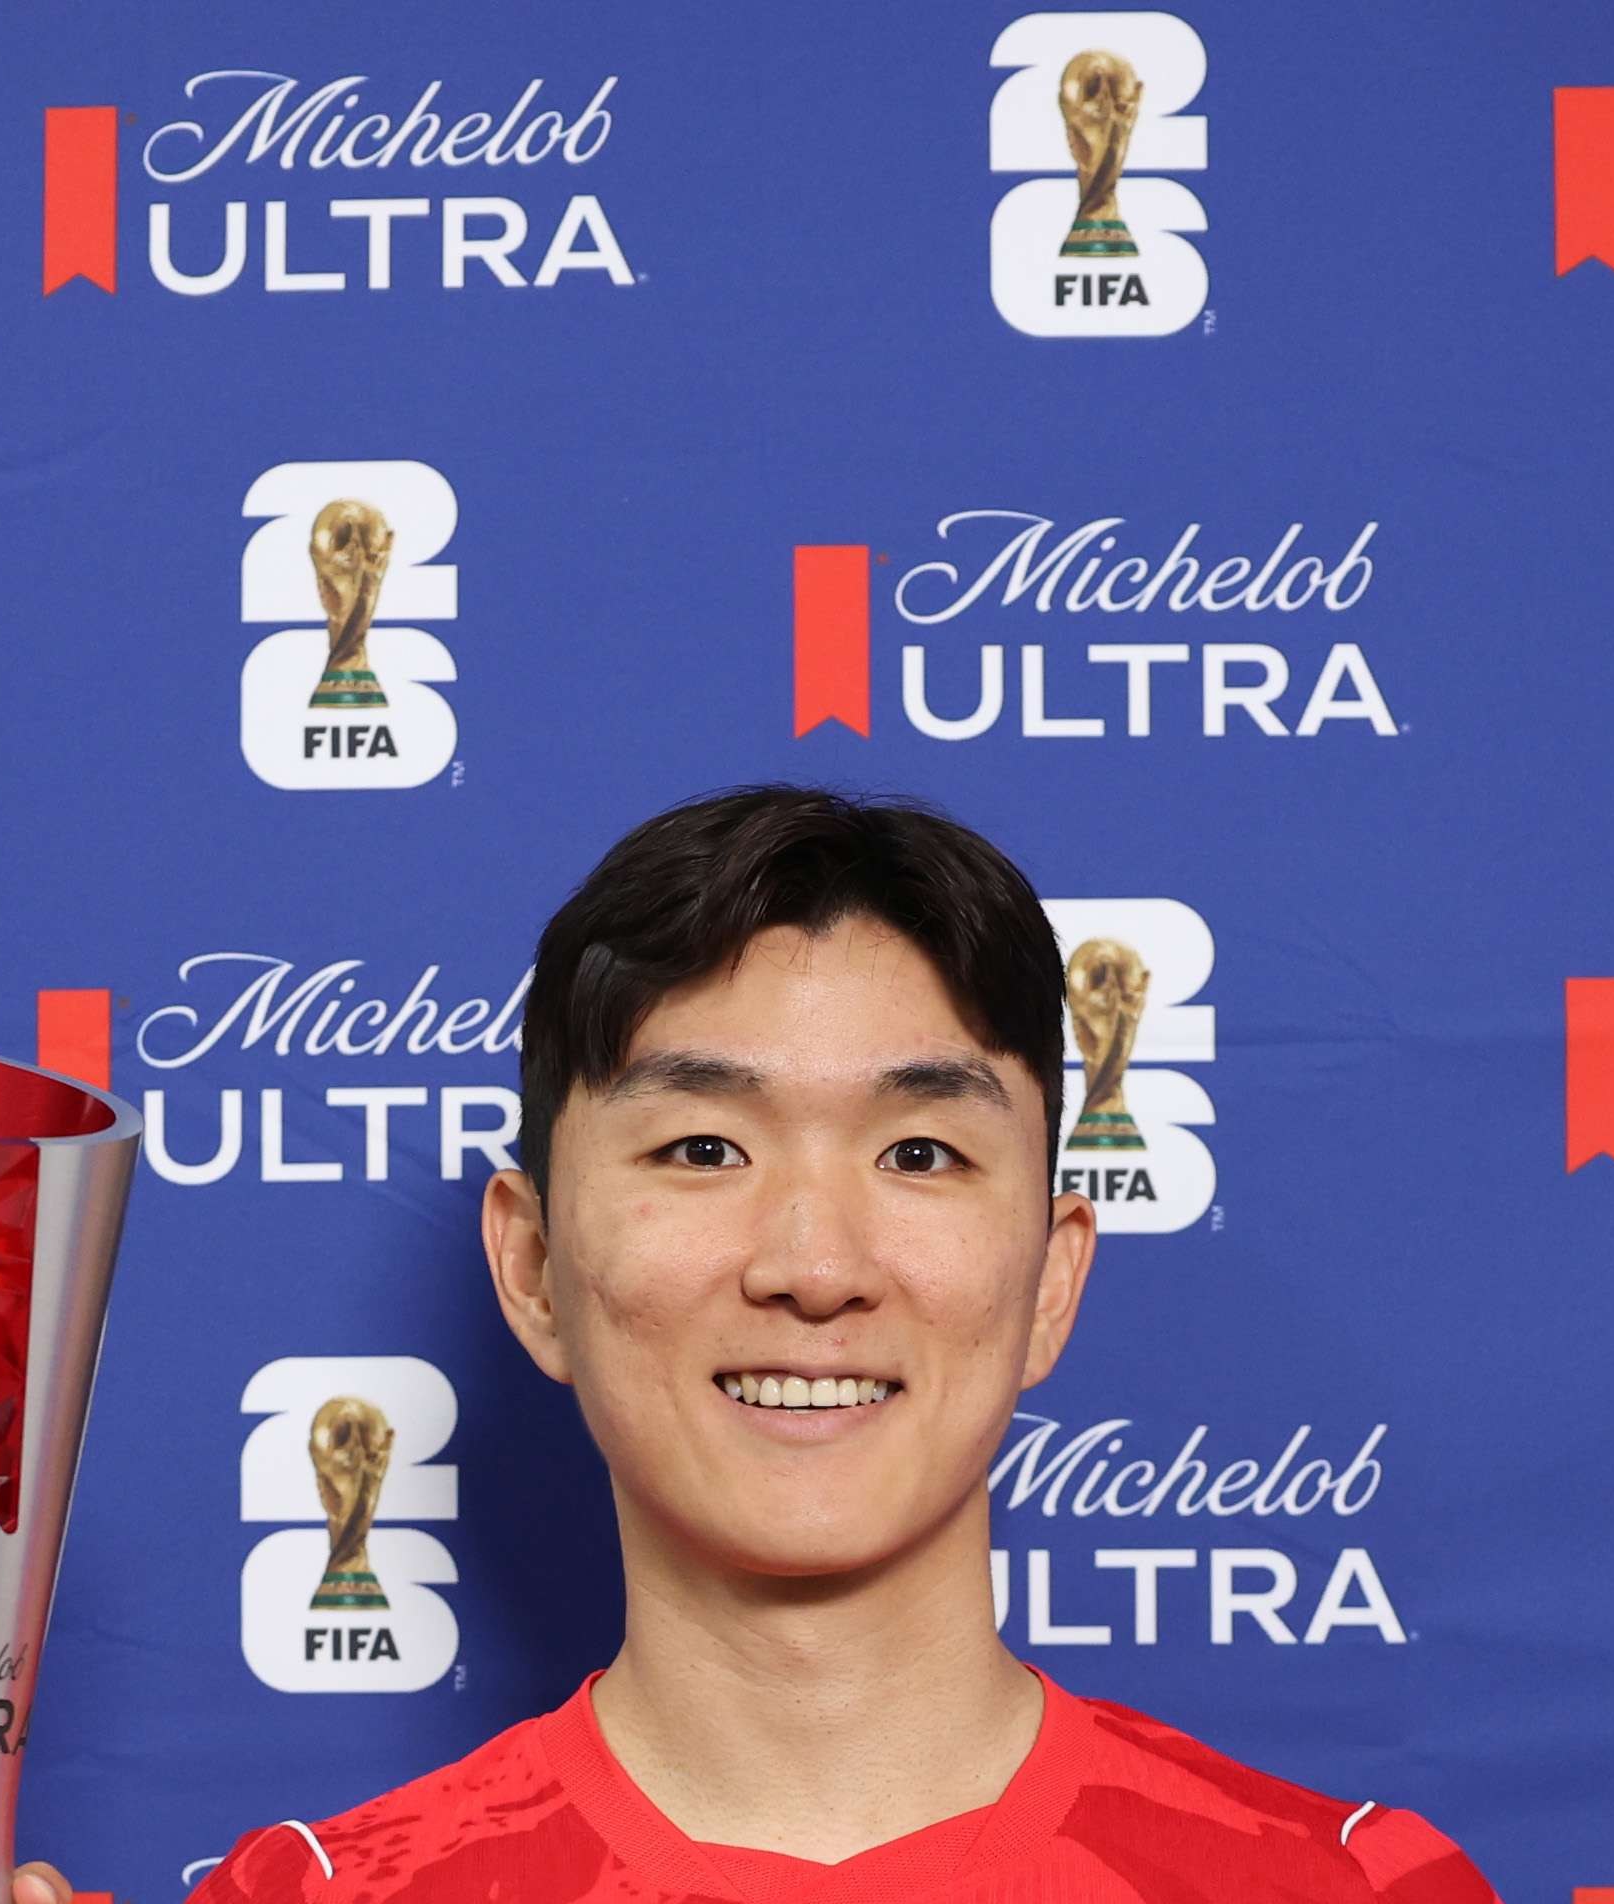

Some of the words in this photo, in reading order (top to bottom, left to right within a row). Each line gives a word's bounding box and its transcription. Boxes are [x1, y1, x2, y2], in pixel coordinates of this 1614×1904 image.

[143, 71, 618, 183] Michelob
[149, 195, 635, 296] ULTRA
[1055, 274, 1149, 306] FIFA
[895, 510, 1378, 624] Michelob
[903, 644, 1398, 741] ULTRA
[304, 726, 398, 759] FIFA
[137, 953, 536, 1068] Michel
[1061, 1168, 1158, 1202] FIFA
[305, 1628, 400, 1661] FIFA
